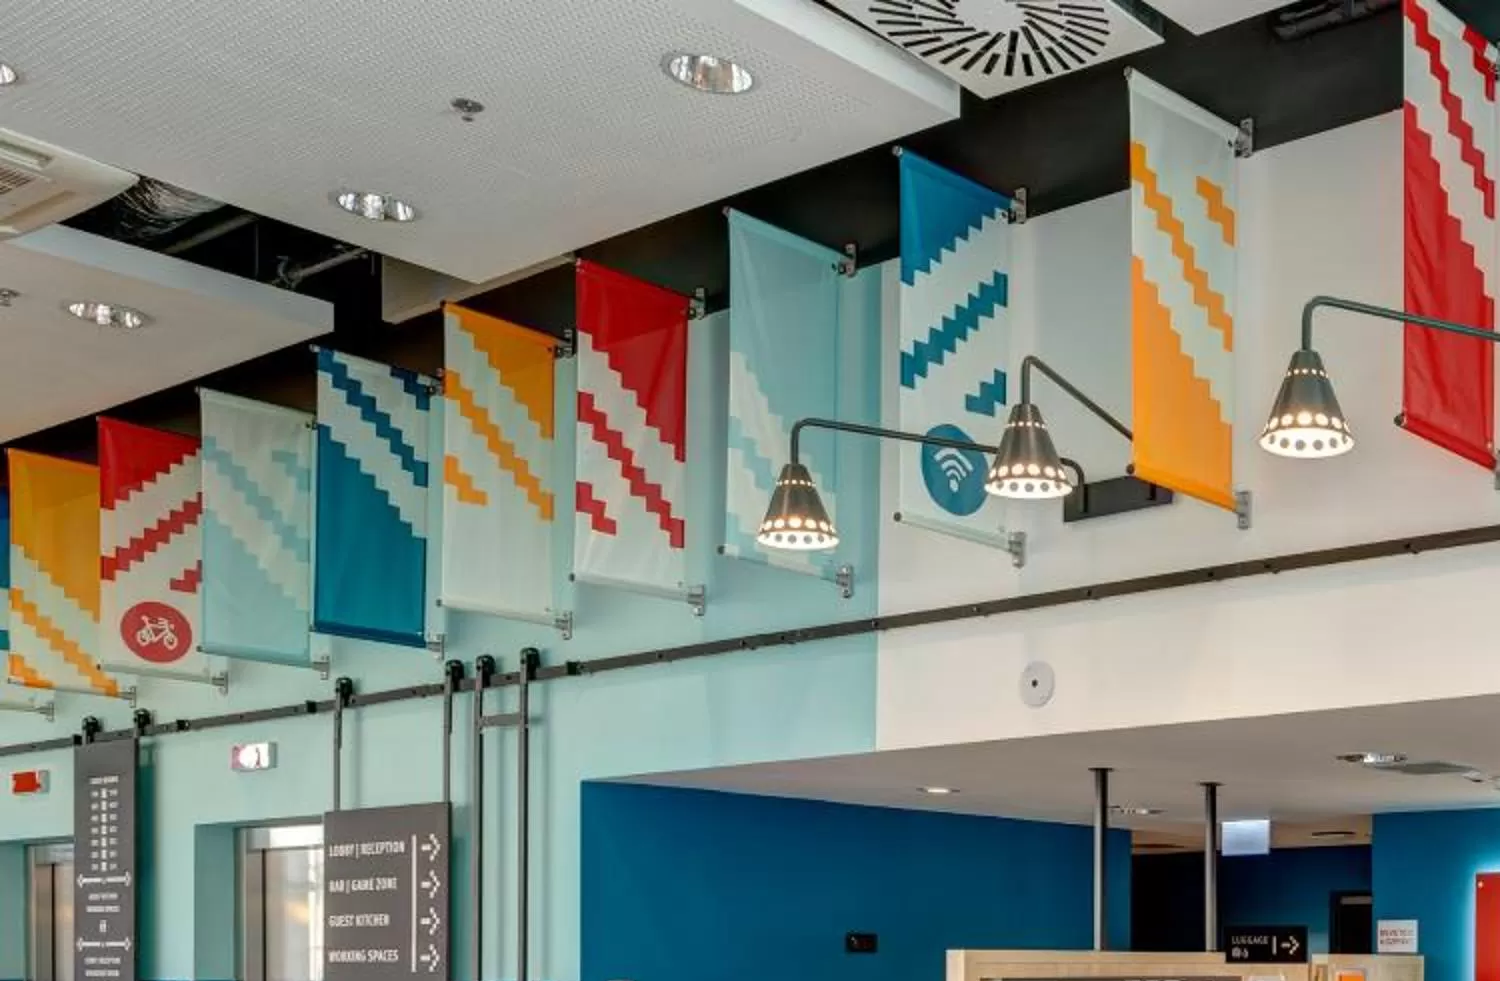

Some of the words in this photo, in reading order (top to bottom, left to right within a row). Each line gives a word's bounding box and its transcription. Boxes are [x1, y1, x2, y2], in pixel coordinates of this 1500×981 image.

[360, 841, 405, 855] RECEPTION
[328, 914, 355, 927] GUEST
[356, 913, 390, 926] KITCHEN
[1231, 935, 1269, 945] LUGGAGE
[328, 949, 366, 963] WORKING
[367, 949, 399, 962] SPACES
